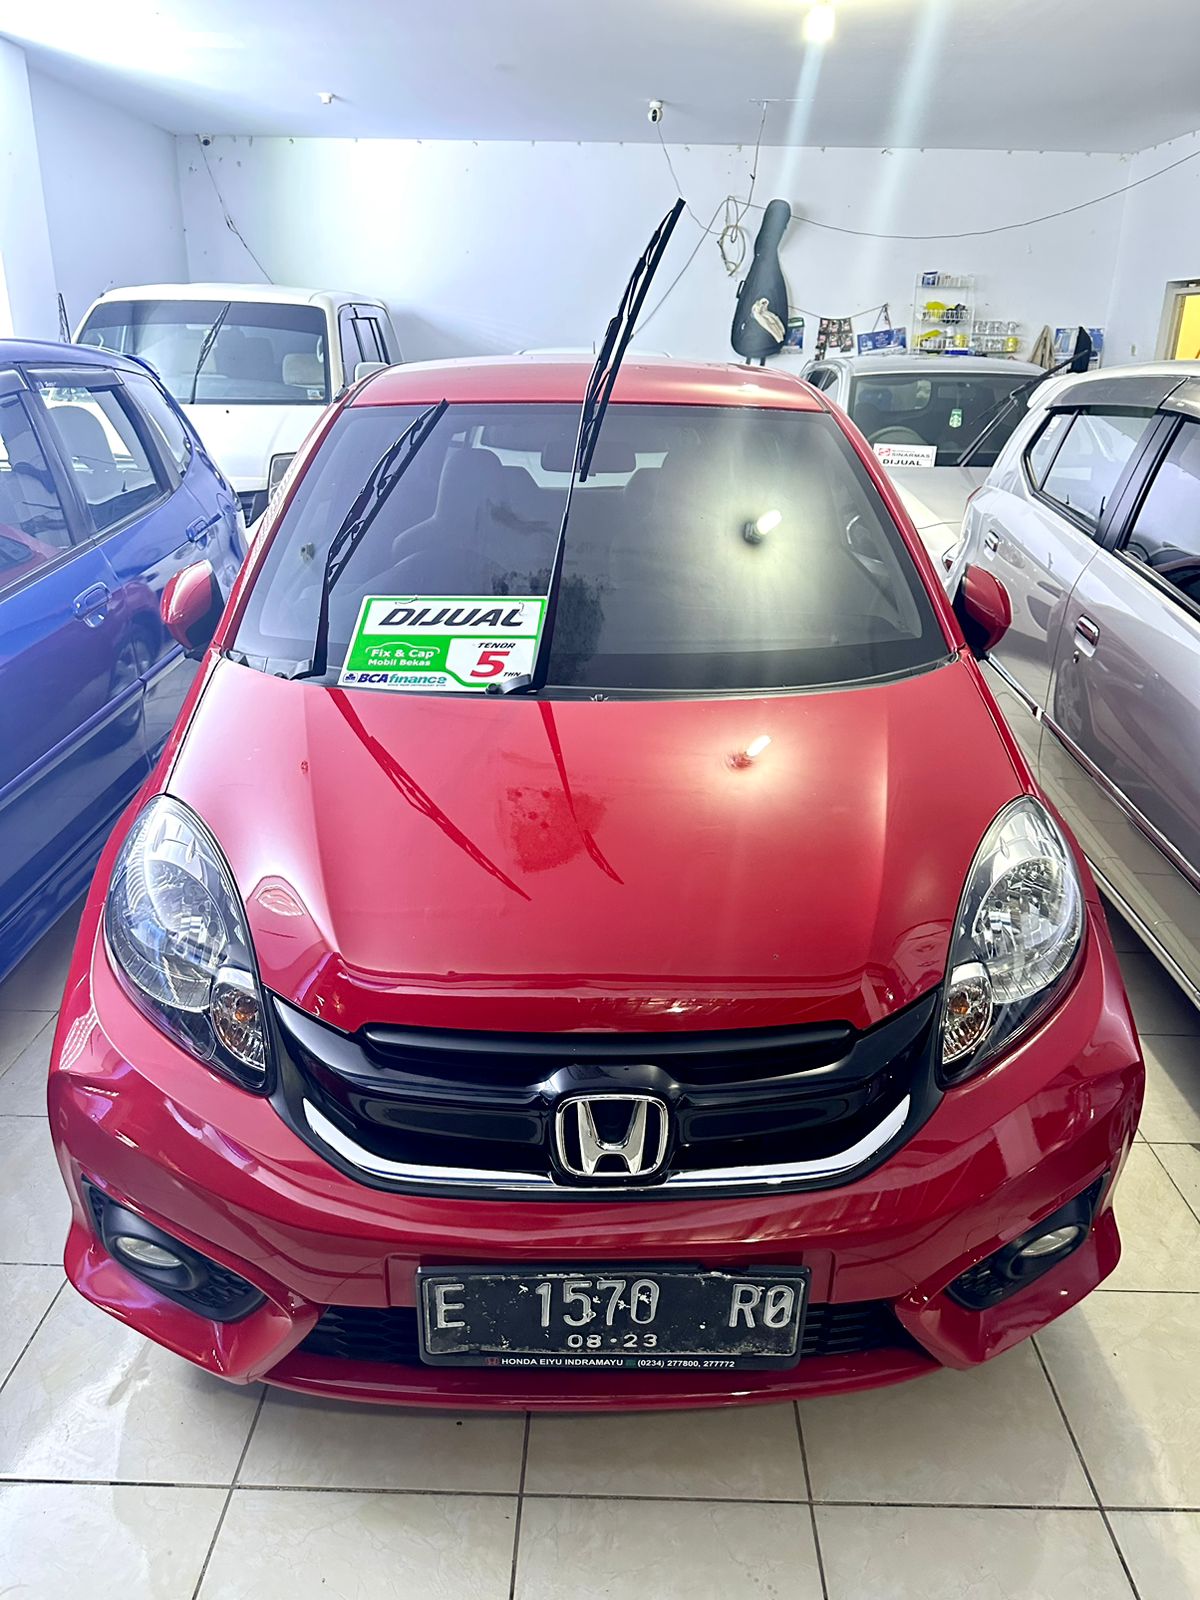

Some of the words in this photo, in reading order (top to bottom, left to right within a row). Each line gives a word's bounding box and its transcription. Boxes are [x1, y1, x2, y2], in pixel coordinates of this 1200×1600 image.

[882, 458, 923, 466] DIJUAL
[378, 608, 524, 627] DIJUAL
[370, 648, 391, 658] Fix
[394, 648, 405, 658] &
[408, 648, 435, 659] Cap
[367, 658, 397, 667] Mobil
[399, 659, 432, 667] Bekas
[469, 650, 511, 678] 5
[434, 1283, 466, 1329] E
[534, 1278, 660, 1328] 1570
[501, 1358, 538, 1366] HONDA
[539, 1358, 562, 1366] EIYU
[564, 1358, 624, 1367] INDRAMAYU
[637, 1359, 665, 1368] (0234)
[667, 1359, 701, 1368] 277800,
[703, 1360, 735, 1368] 277772
